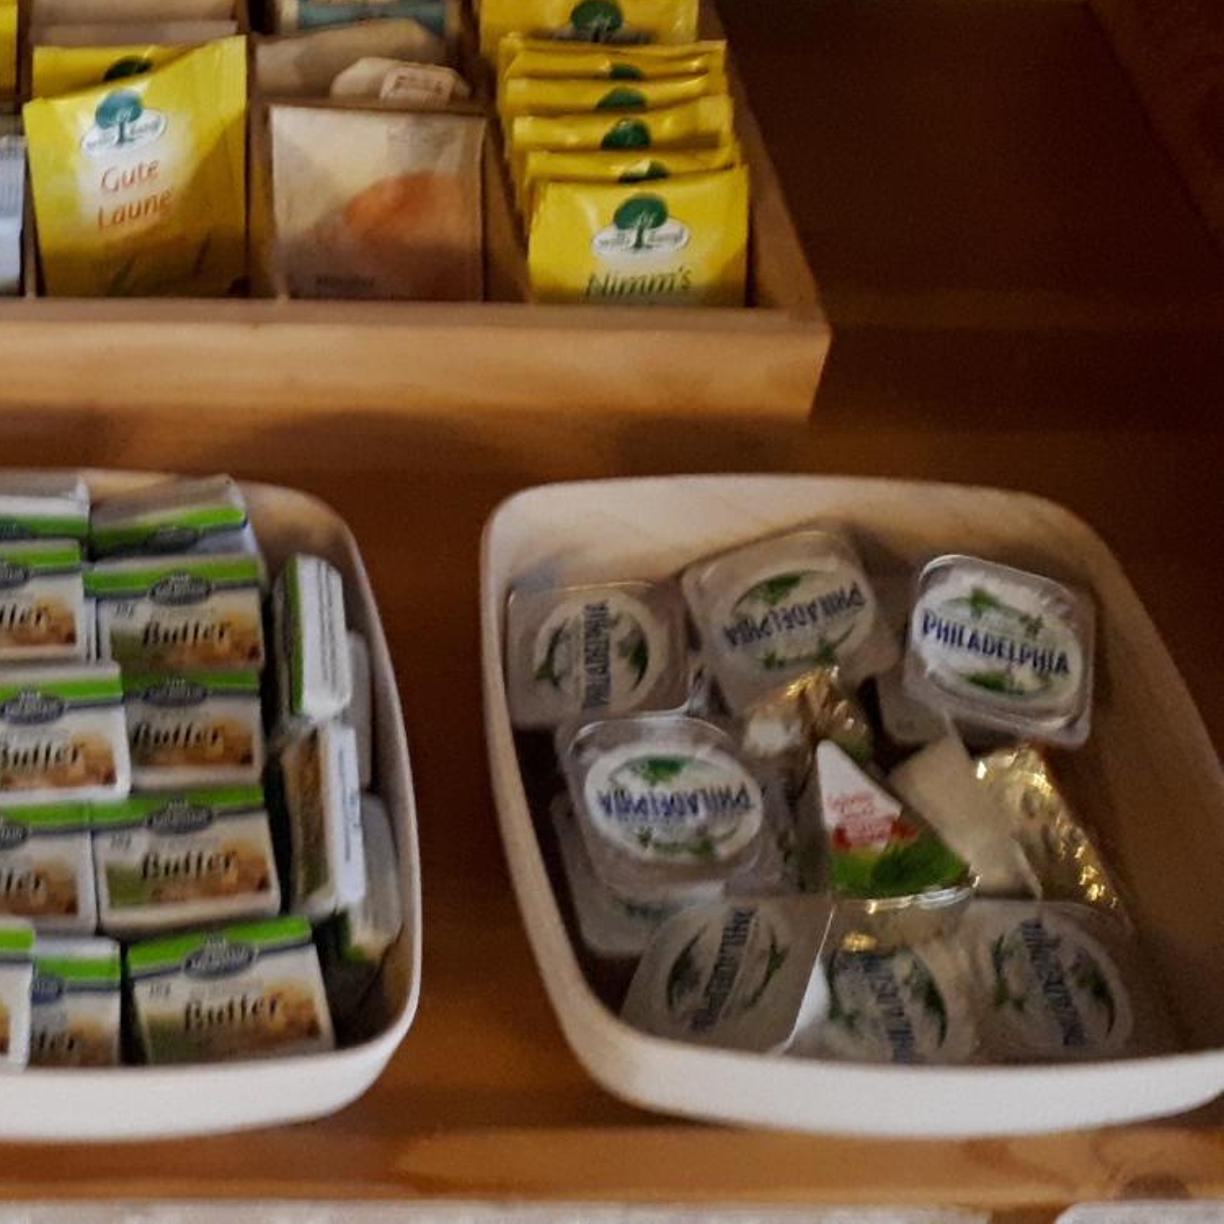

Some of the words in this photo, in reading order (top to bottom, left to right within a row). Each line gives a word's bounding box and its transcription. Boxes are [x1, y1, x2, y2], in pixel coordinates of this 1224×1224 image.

[101, 159, 160, 193] Gute
[98, 189, 172, 231] Laune
[585, 265, 691, 298] Nimm's
[142, 620, 231, 647] Butter
[921, 608, 1069, 675] PHILADELPHIA
[133, 721, 226, 747] Butter
[141, 850, 237, 880] Butter
[184, 993, 283, 1031] Butter
